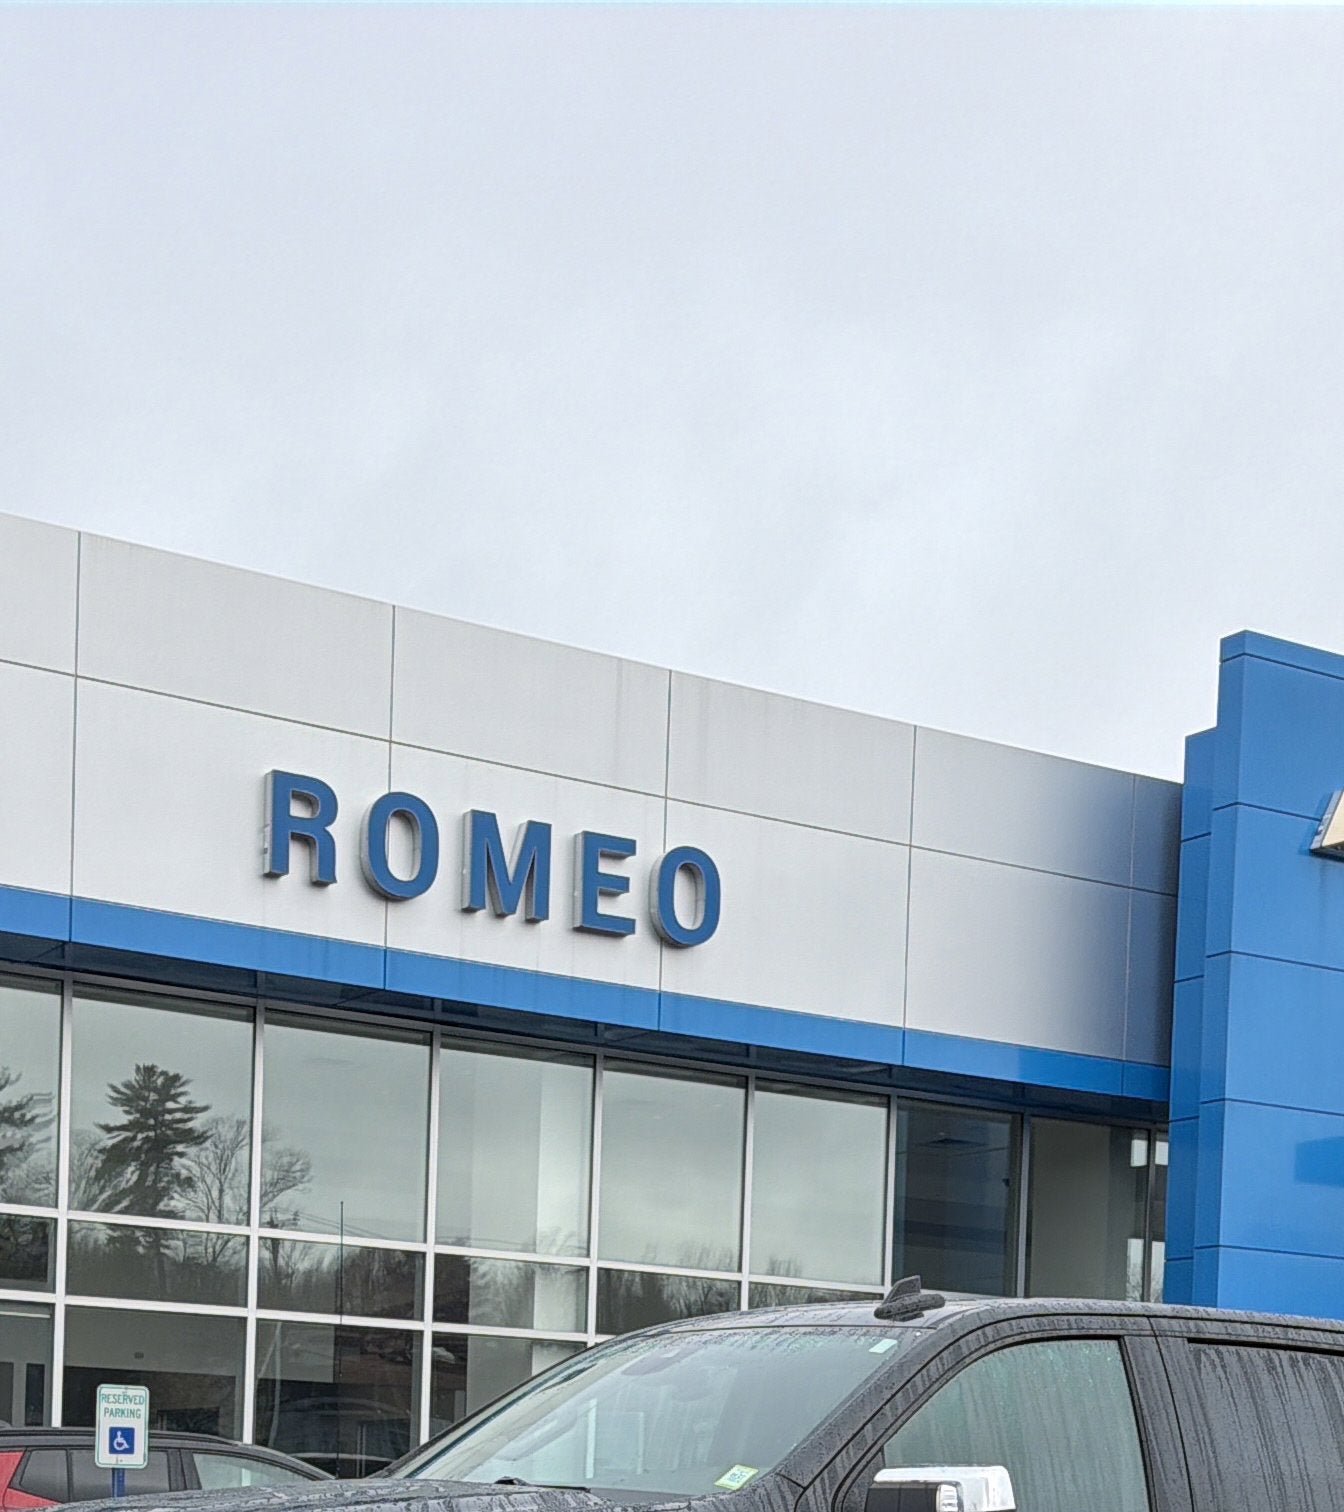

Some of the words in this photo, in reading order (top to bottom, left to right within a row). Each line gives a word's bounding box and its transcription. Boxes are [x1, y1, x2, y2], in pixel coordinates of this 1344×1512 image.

[263, 768, 721, 948] ROMEO
[102, 1394, 144, 1405] RESERVED
[104, 1407, 142, 1419] PARKING
